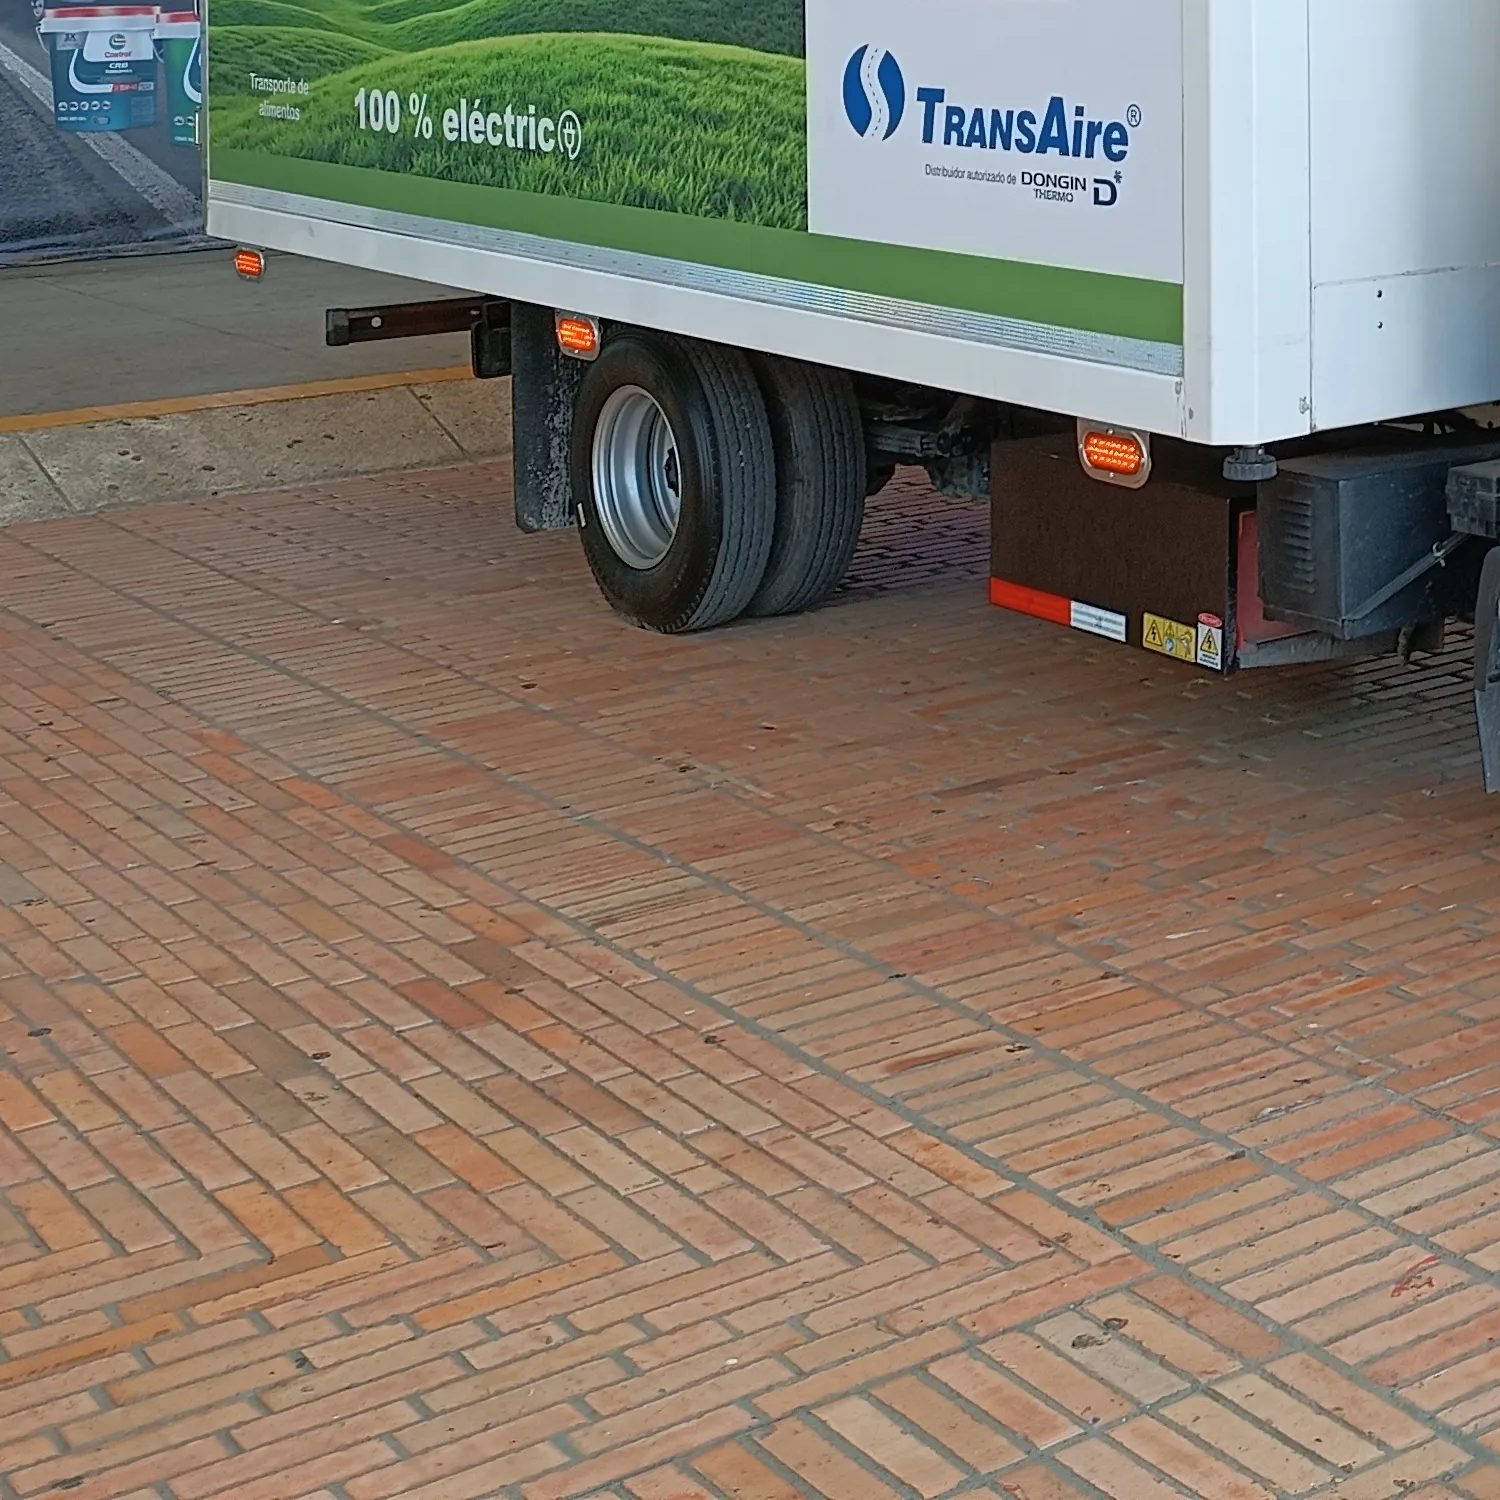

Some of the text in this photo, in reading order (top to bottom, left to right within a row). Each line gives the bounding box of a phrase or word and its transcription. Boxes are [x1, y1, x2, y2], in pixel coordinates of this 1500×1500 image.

[249, 72, 309, 96] Transporte de
[258, 99, 300, 121] alimentos
[354, 87, 400, 134] 100
[409, 92, 433, 140] %
[925, 163, 966, 179] Distribuidor
[966, 168, 1006, 184] autorizado
[1006, 171, 1017, 185] de
[1021, 171, 1087, 192] DONGIN
[1033, 187, 1074, 204] THERMO
